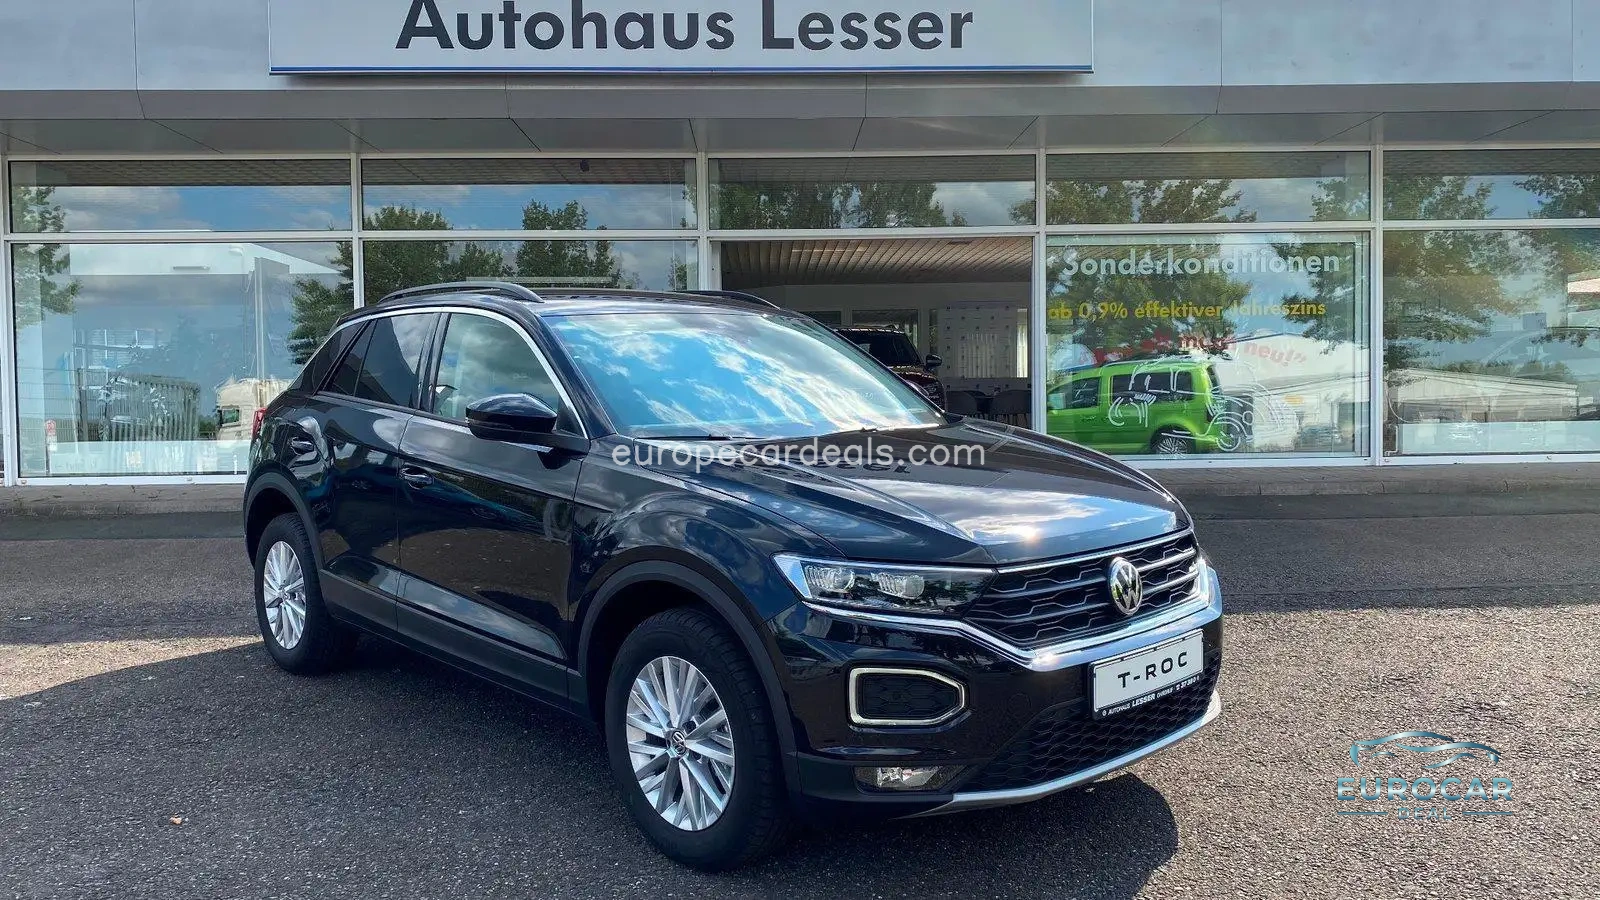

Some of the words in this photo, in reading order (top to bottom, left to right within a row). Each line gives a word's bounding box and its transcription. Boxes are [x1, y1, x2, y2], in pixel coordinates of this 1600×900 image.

[395, 0, 735, 50] Autohaus
[762, 0, 973, 50] Lesser
[1063, 248, 1340, 276] Sonderkonditionen
[1048, 300, 1073, 319] ab
[1079, 302, 1128, 322] 0,9%
[1134, 300, 1223, 319] effektiver
[1118, 652, 1188, 688] T-ROC
[1131, 693, 1156, 707] LESSER
